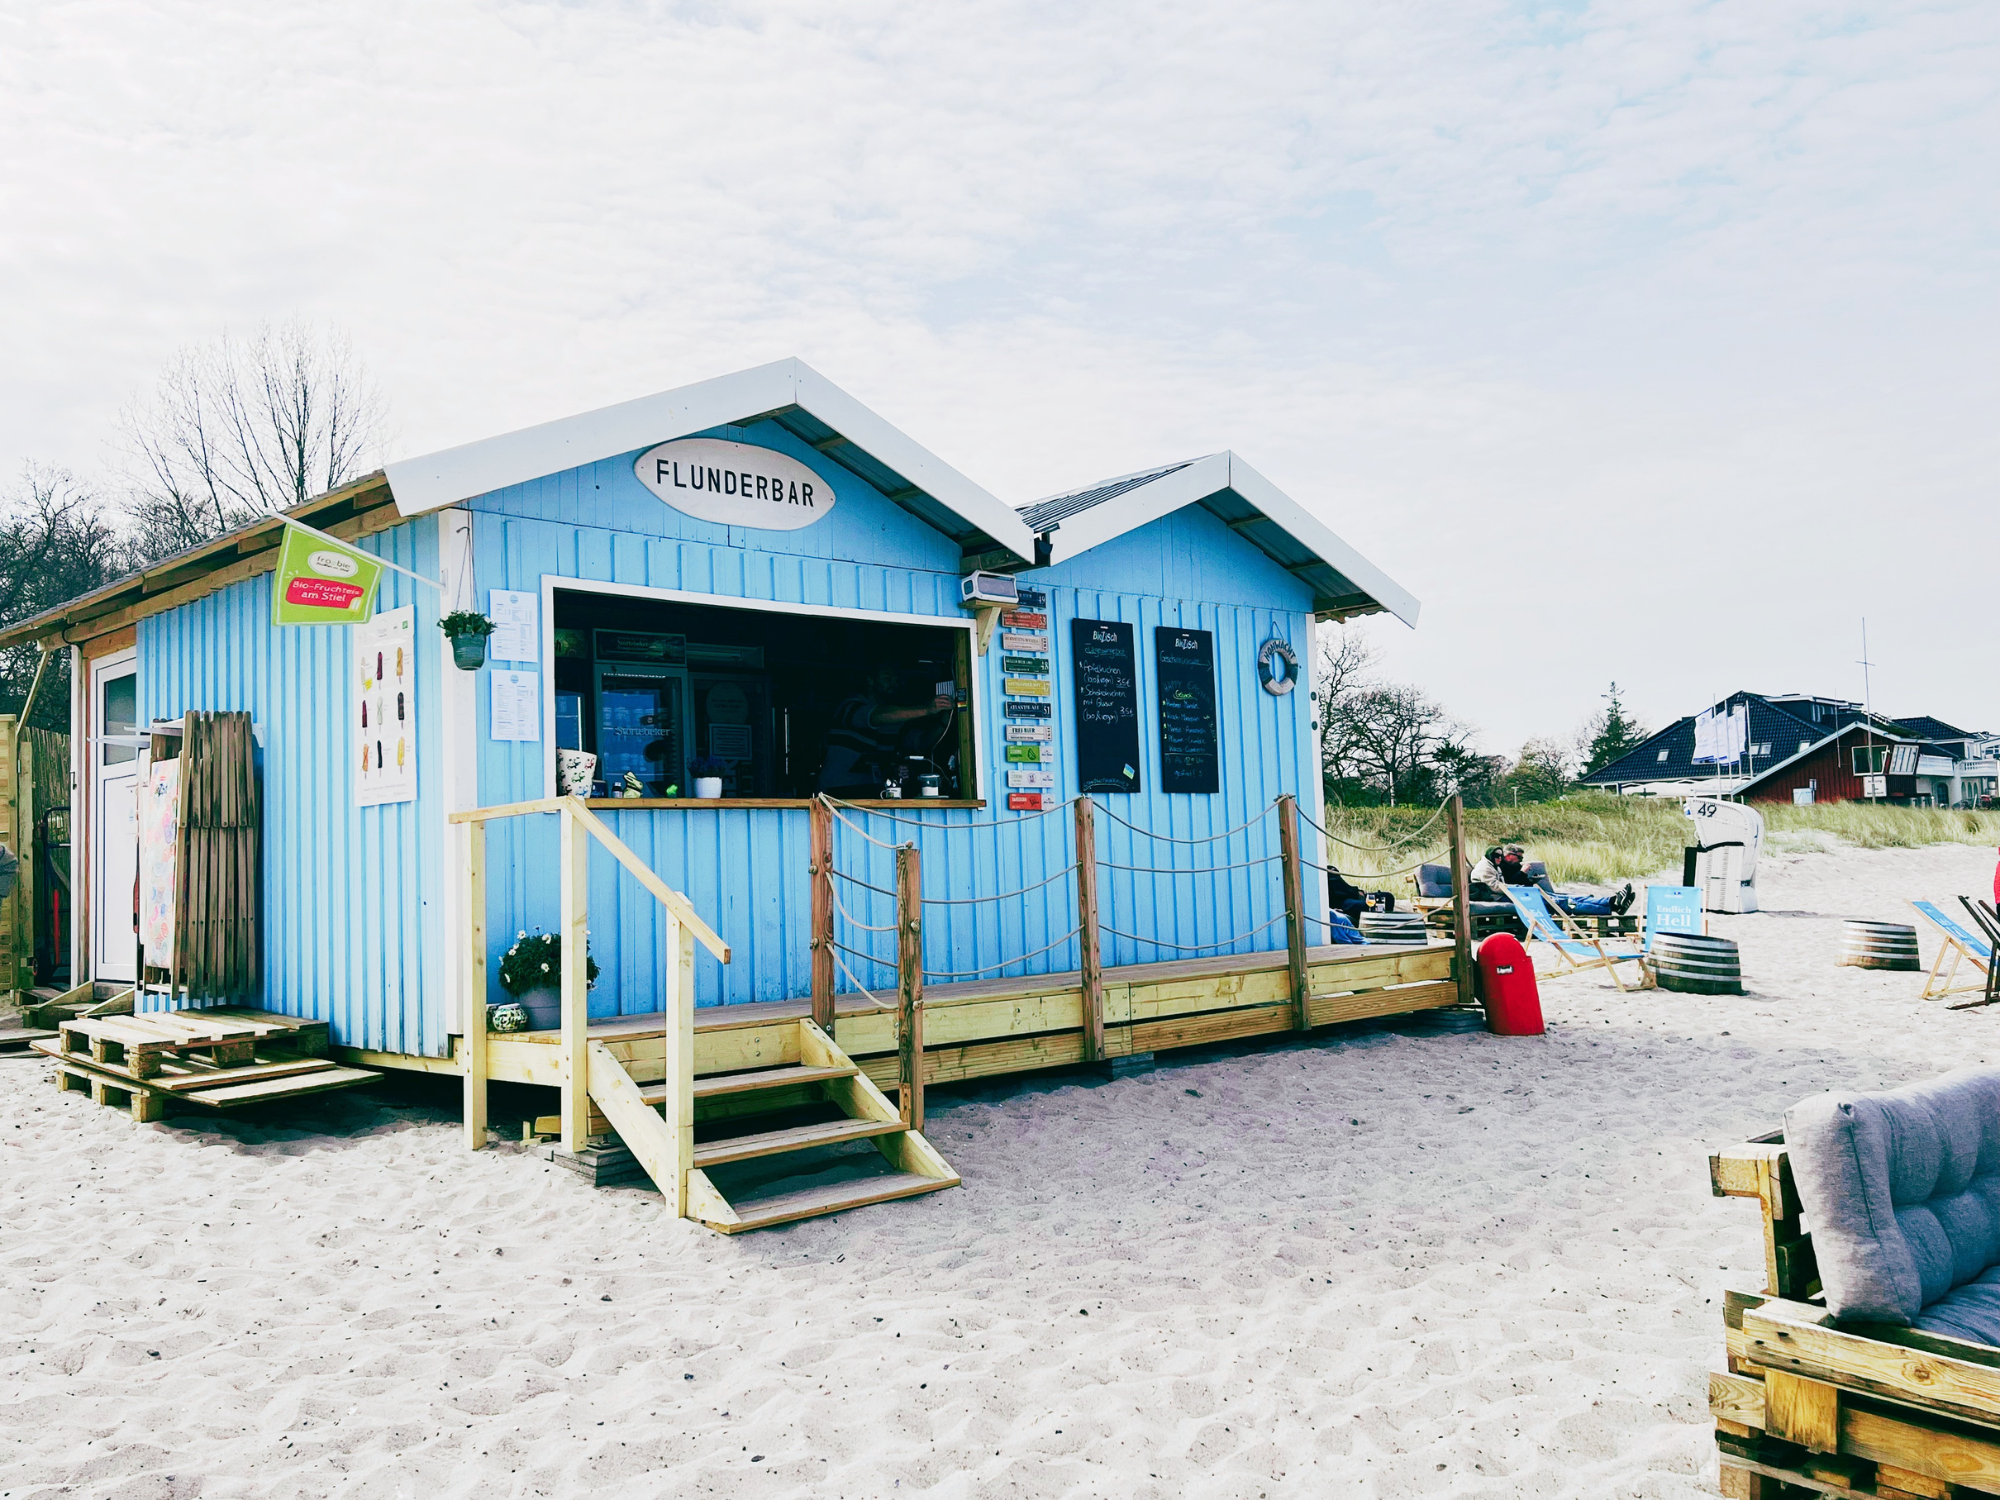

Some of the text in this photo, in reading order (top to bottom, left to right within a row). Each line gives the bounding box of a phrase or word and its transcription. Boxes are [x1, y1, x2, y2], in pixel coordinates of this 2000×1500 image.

[656, 459, 814, 507] FLUNDERBAR
[292, 581, 360, 595] Bio-Fruchteis
[301, 591, 346, 602] am Stiel
[1092, 631, 1117, 643] BioZisch
[1175, 638, 1198, 650] BioZisch
[1697, 803, 1717, 818] 49
[1656, 905, 1691, 913] Endlich
[1656, 914, 1691, 926] Hell
